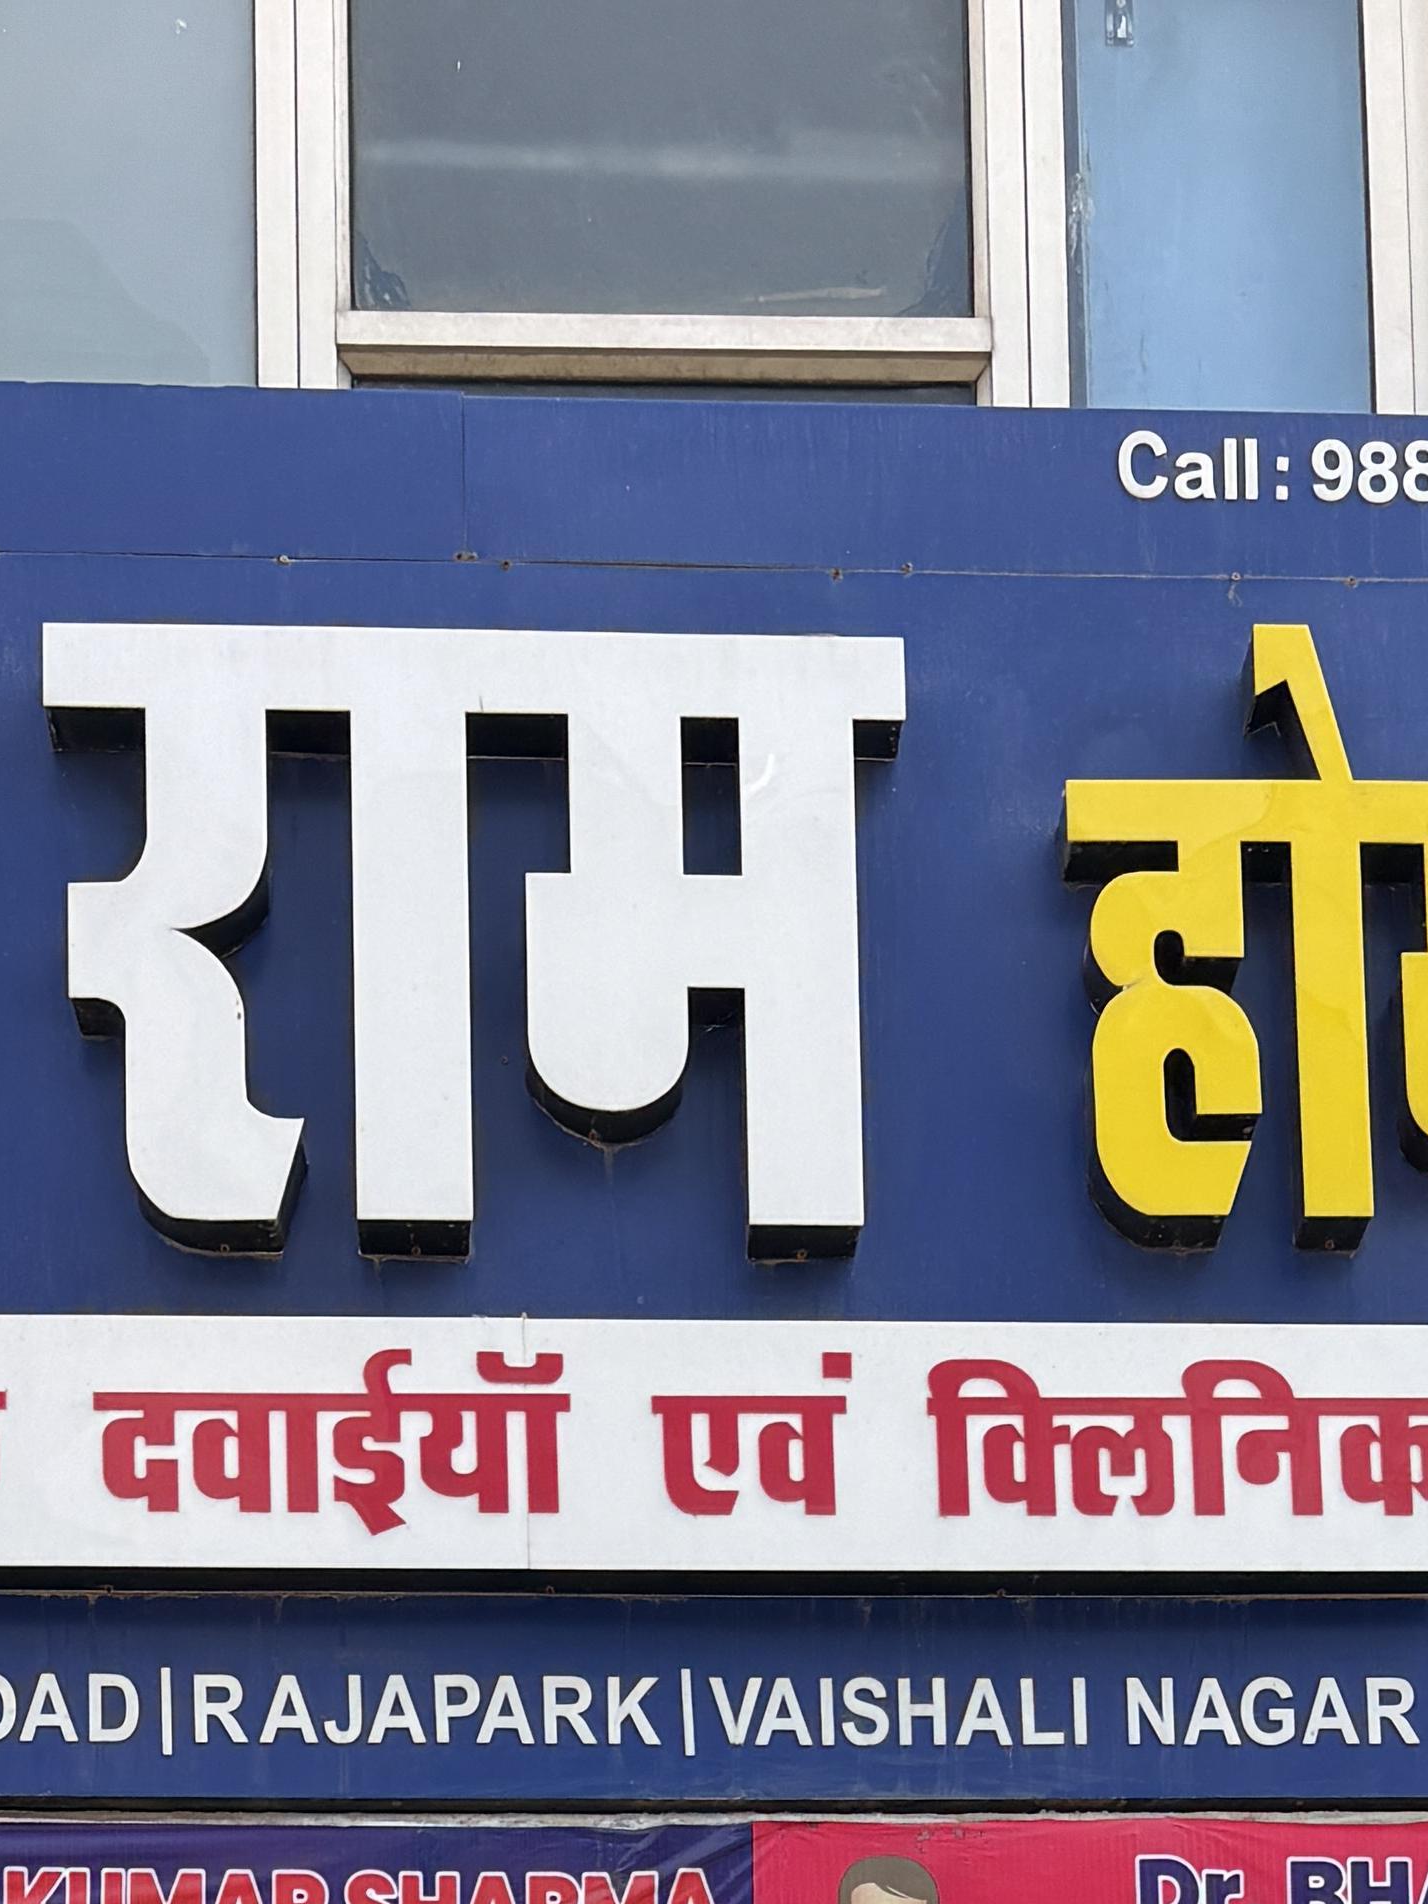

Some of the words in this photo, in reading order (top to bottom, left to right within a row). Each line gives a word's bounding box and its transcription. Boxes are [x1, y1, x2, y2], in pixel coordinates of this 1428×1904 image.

[43, 622, 907, 1232] राम
[652, 1351, 848, 1516] एवं
[708, 1675, 1089, 1747] VAISHALI
[1126, 1676, 1420, 1747] NAGAR
